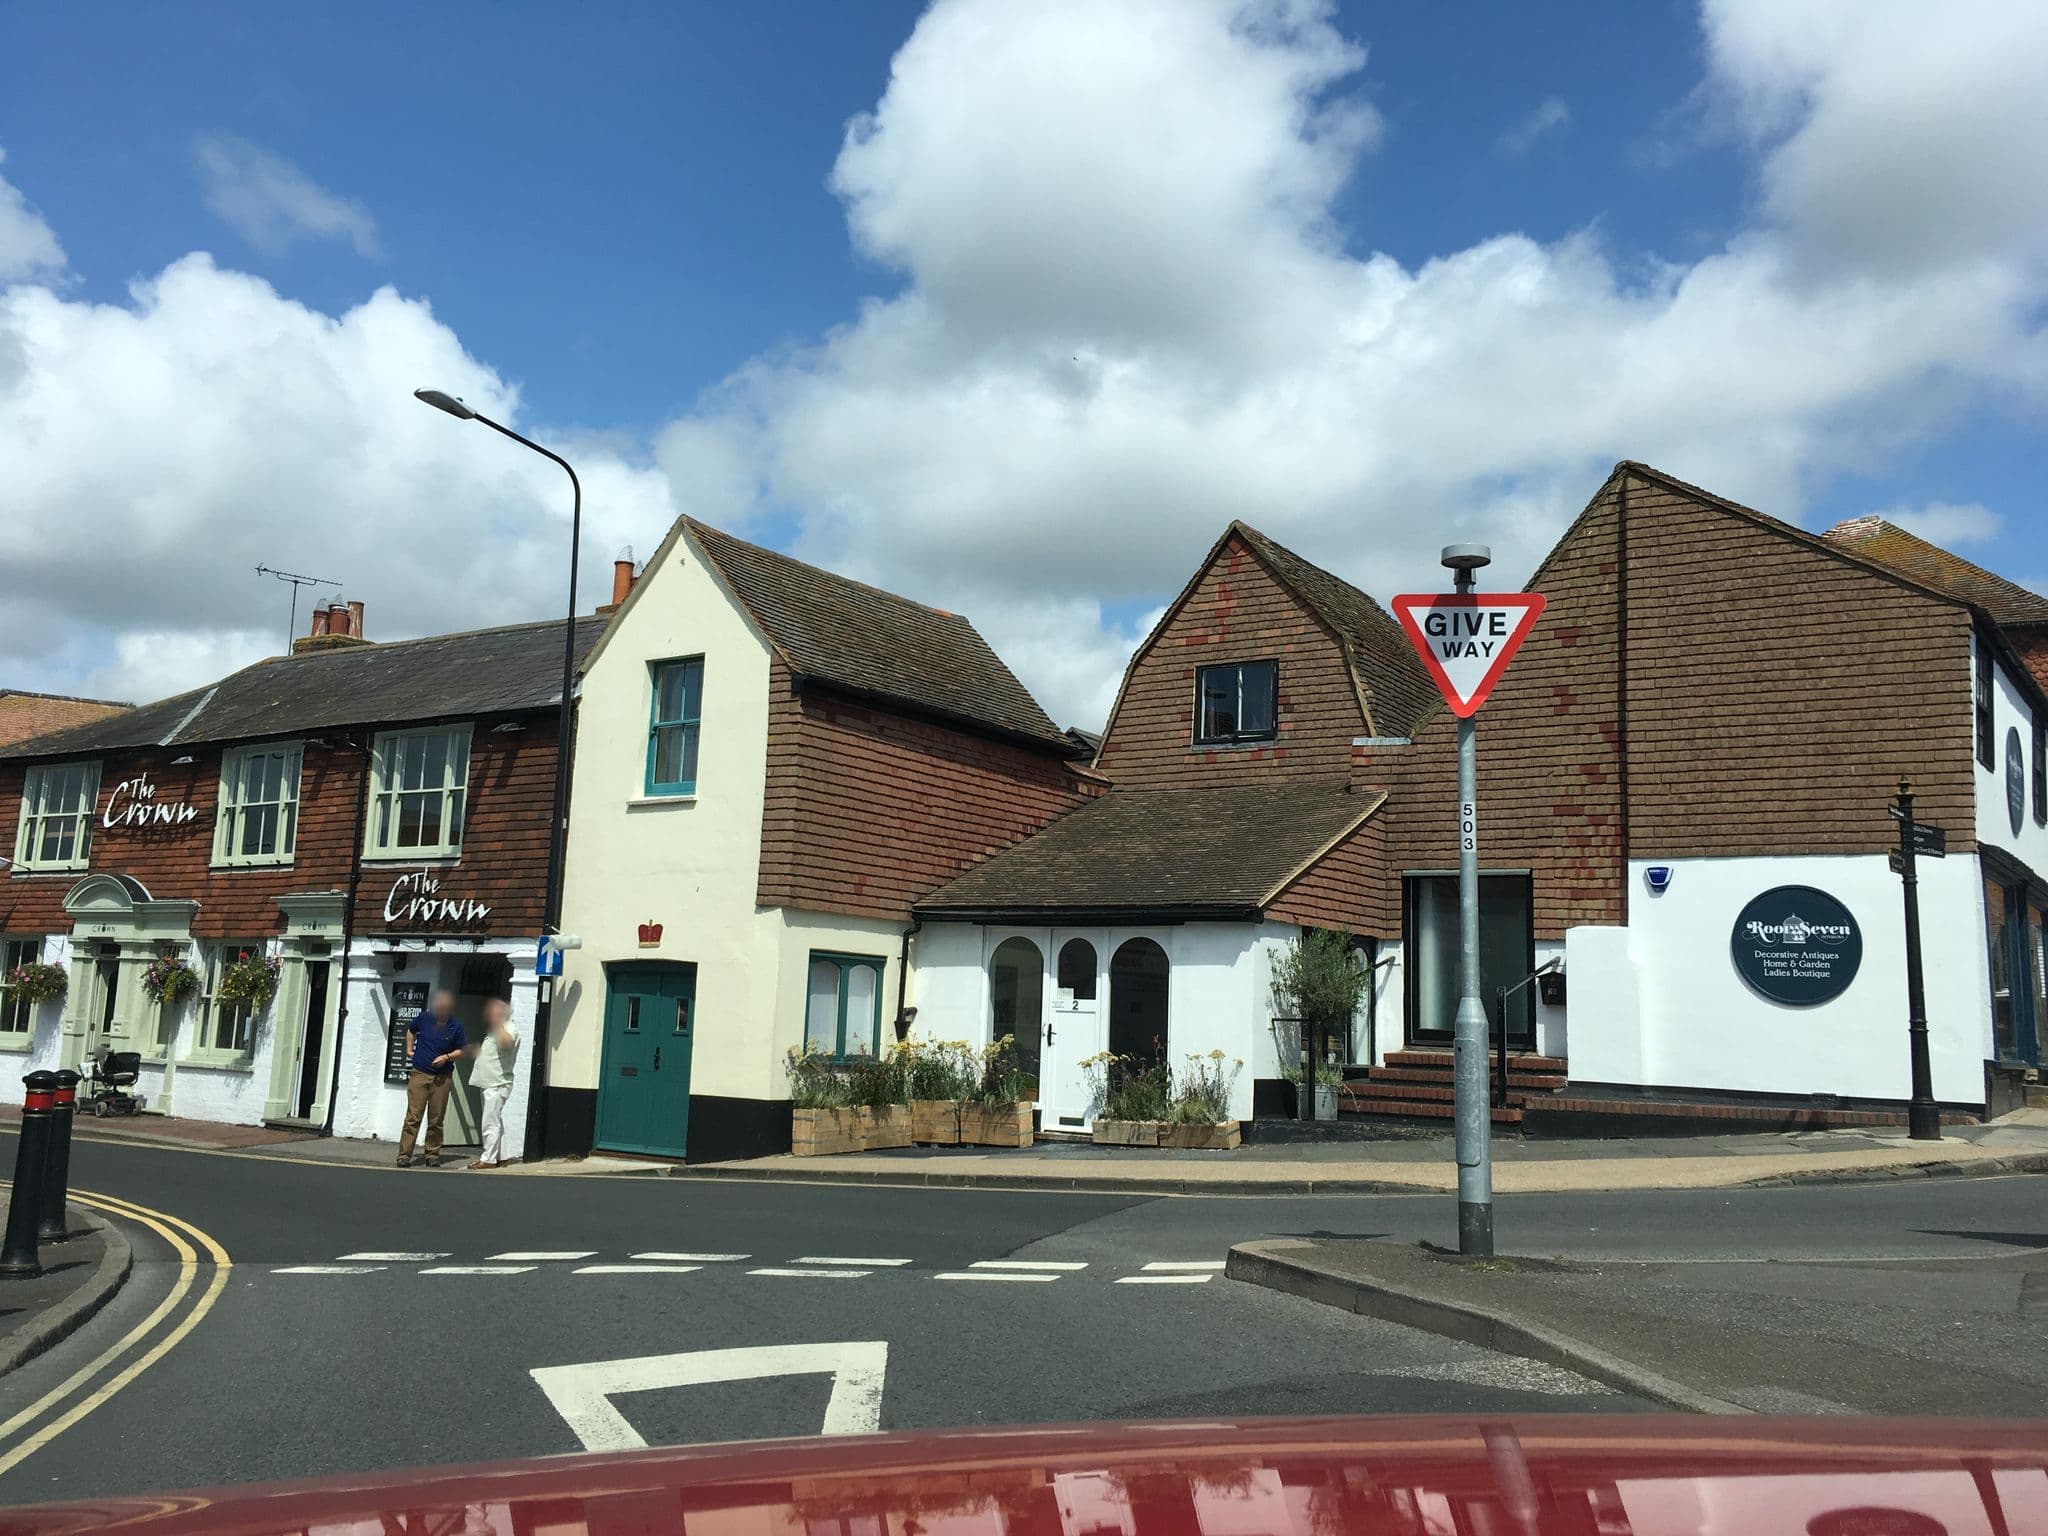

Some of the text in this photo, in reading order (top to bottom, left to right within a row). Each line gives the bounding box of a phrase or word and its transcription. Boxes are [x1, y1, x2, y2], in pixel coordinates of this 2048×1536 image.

[1424, 612, 1507, 637] GIVE
[1442, 641, 1495, 658] WAY
[130, 771, 156, 800] The
[102, 781, 200, 828] Crown
[1463, 803, 1474, 850] 503
[410, 865, 441, 894] The
[383, 874, 492, 922] Crown
[1799, 922, 1851, 939] Seven
[1754, 950, 1840, 960] Decorative Antiques
[1763, 960, 1831, 969] Home & Garden
[1764, 968, 1831, 979] Ladies Boutique
[1072, 1000, 1079, 1011] 2
